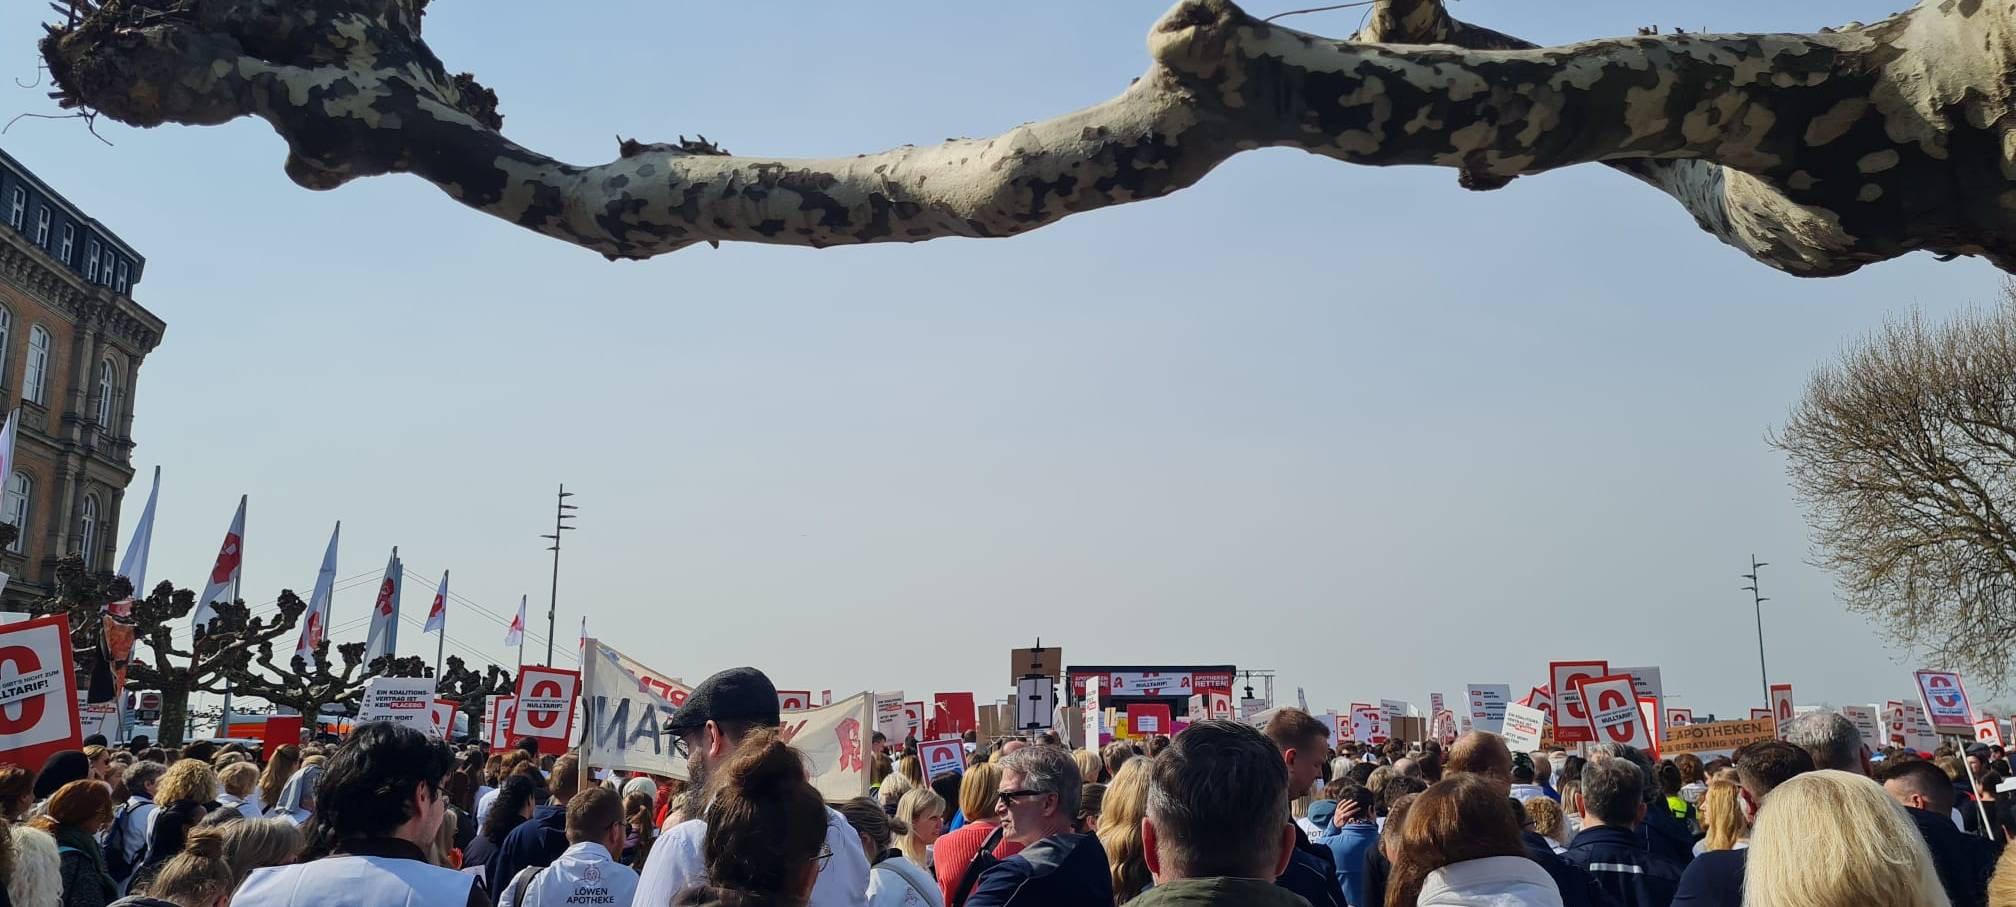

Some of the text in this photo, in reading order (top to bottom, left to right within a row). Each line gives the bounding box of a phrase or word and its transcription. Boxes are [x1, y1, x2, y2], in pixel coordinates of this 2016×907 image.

[24, 674, 43, 682] NICHT
[0, 680, 48, 699] LTARIF!
[1601, 712, 1633, 723] NULLTARIF!
[1676, 740, 1727, 752] BERATUNG
[1729, 738, 1750, 746] VOR
[574, 886, 608, 896] LÖWEN
